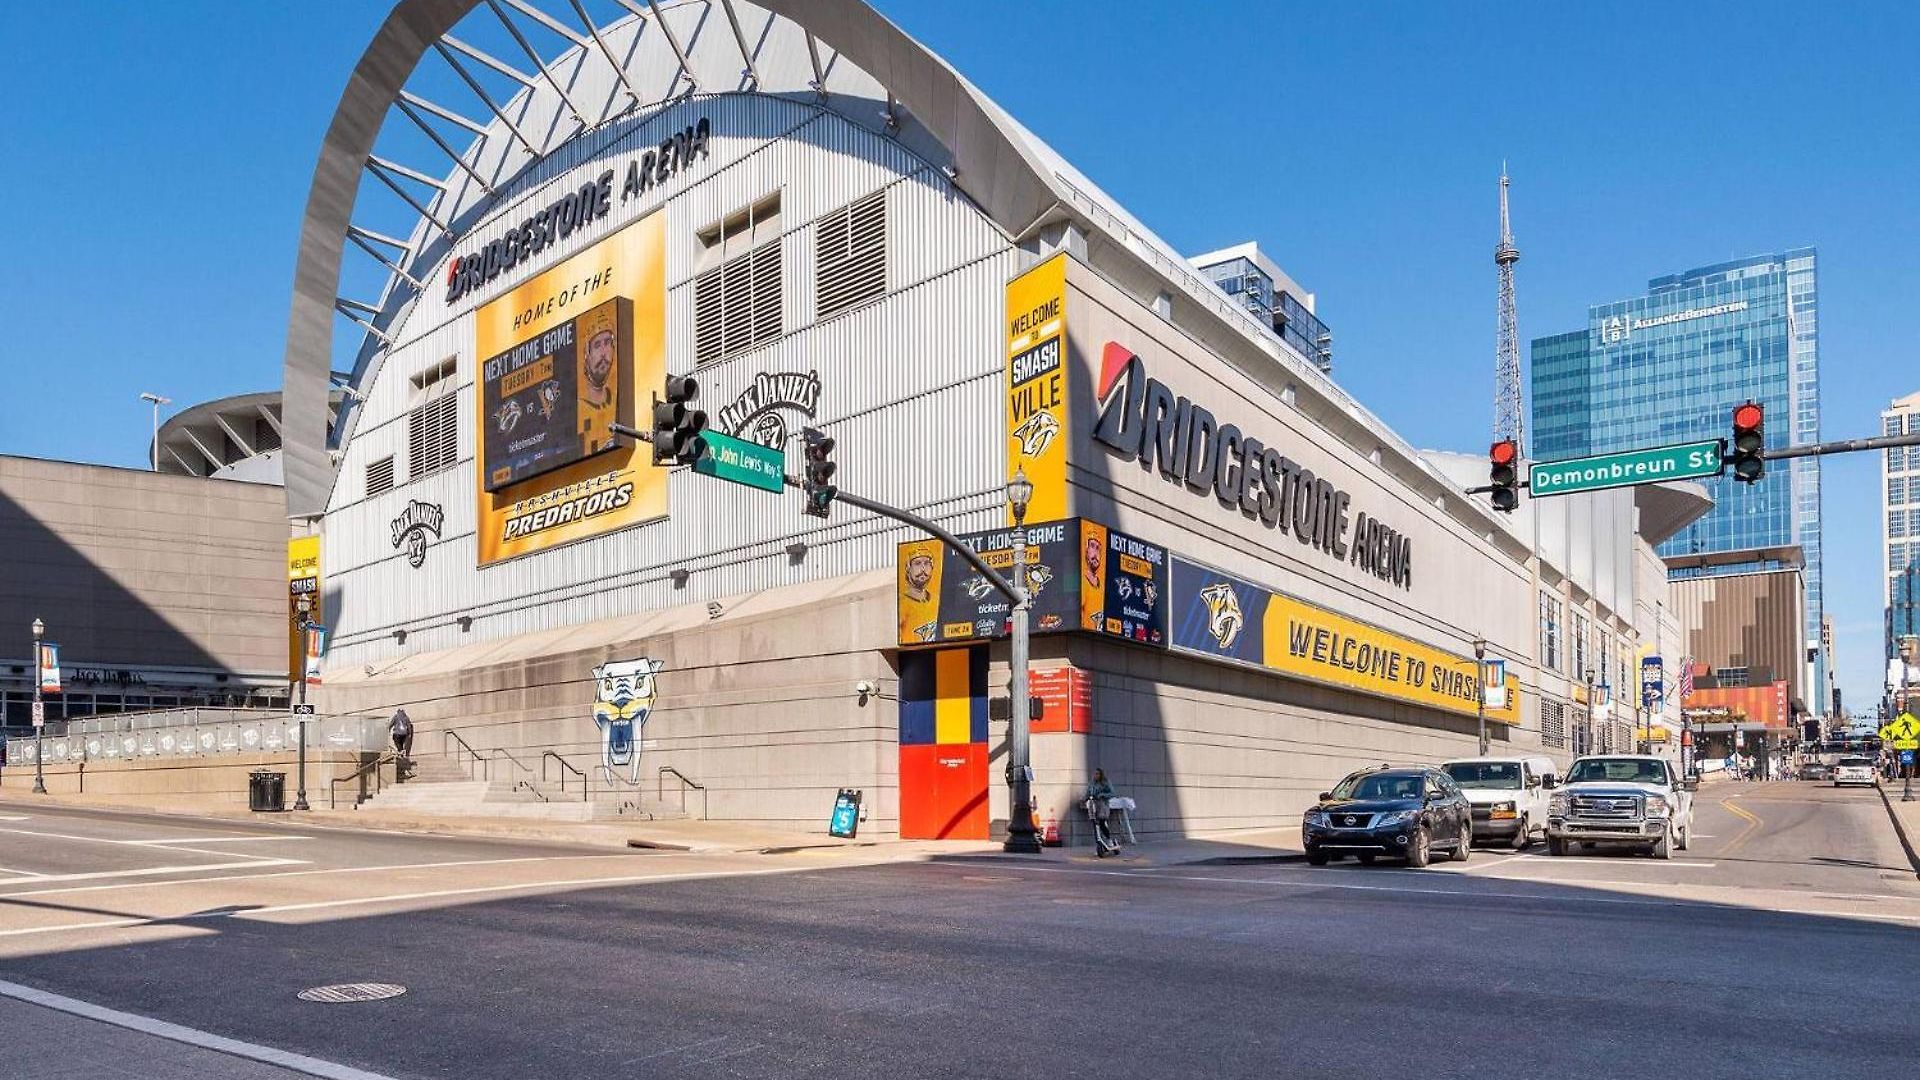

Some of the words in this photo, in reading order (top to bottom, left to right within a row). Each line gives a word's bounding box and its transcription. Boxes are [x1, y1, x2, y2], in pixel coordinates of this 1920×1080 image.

[447, 169, 615, 301] BRIDGESTONE
[621, 117, 710, 206] ARENA
[512, 297, 554, 331] HOME
[559, 284, 578, 307] OF
[584, 267, 612, 297] THE
[1011, 297, 1060, 337] WELCOME
[485, 354, 508, 382] NEXT
[512, 339, 540, 370] HOME
[543, 323, 573, 355] GAME
[1030, 331, 1039, 341] TO
[1013, 340, 1059, 383] SMASH
[719, 385, 758, 436] JACK
[1011, 374, 1061, 422] VILLE
[718, 445, 738, 466] John
[740, 450, 761, 472] Lewis
[764, 461, 776, 479] Way
[776, 465, 782, 477] S
[1092, 340, 1351, 562] BRIDGESTONE
[1350, 511, 1413, 592] ARENA
[1537, 456, 1675, 488] Demonbreun
[1688, 450, 1714, 469] St
[503, 482, 634, 544] PREDATORS
[512, 471, 617, 515] NASHVILLE
[980, 552, 1015, 565] UESDAY
[987, 531, 1015, 551] HOM
[1027, 525, 1065, 545] GAME
[1110, 532, 1126, 552] NEXT
[1128, 539, 1145, 560] HOME
[291, 556, 317, 571] WELCOME
[291, 576, 317, 594] SMASH
[1288, 619, 1401, 682] WELCOME
[1406, 656, 1427, 687] TO
[71, 667, 101, 683] JACK
